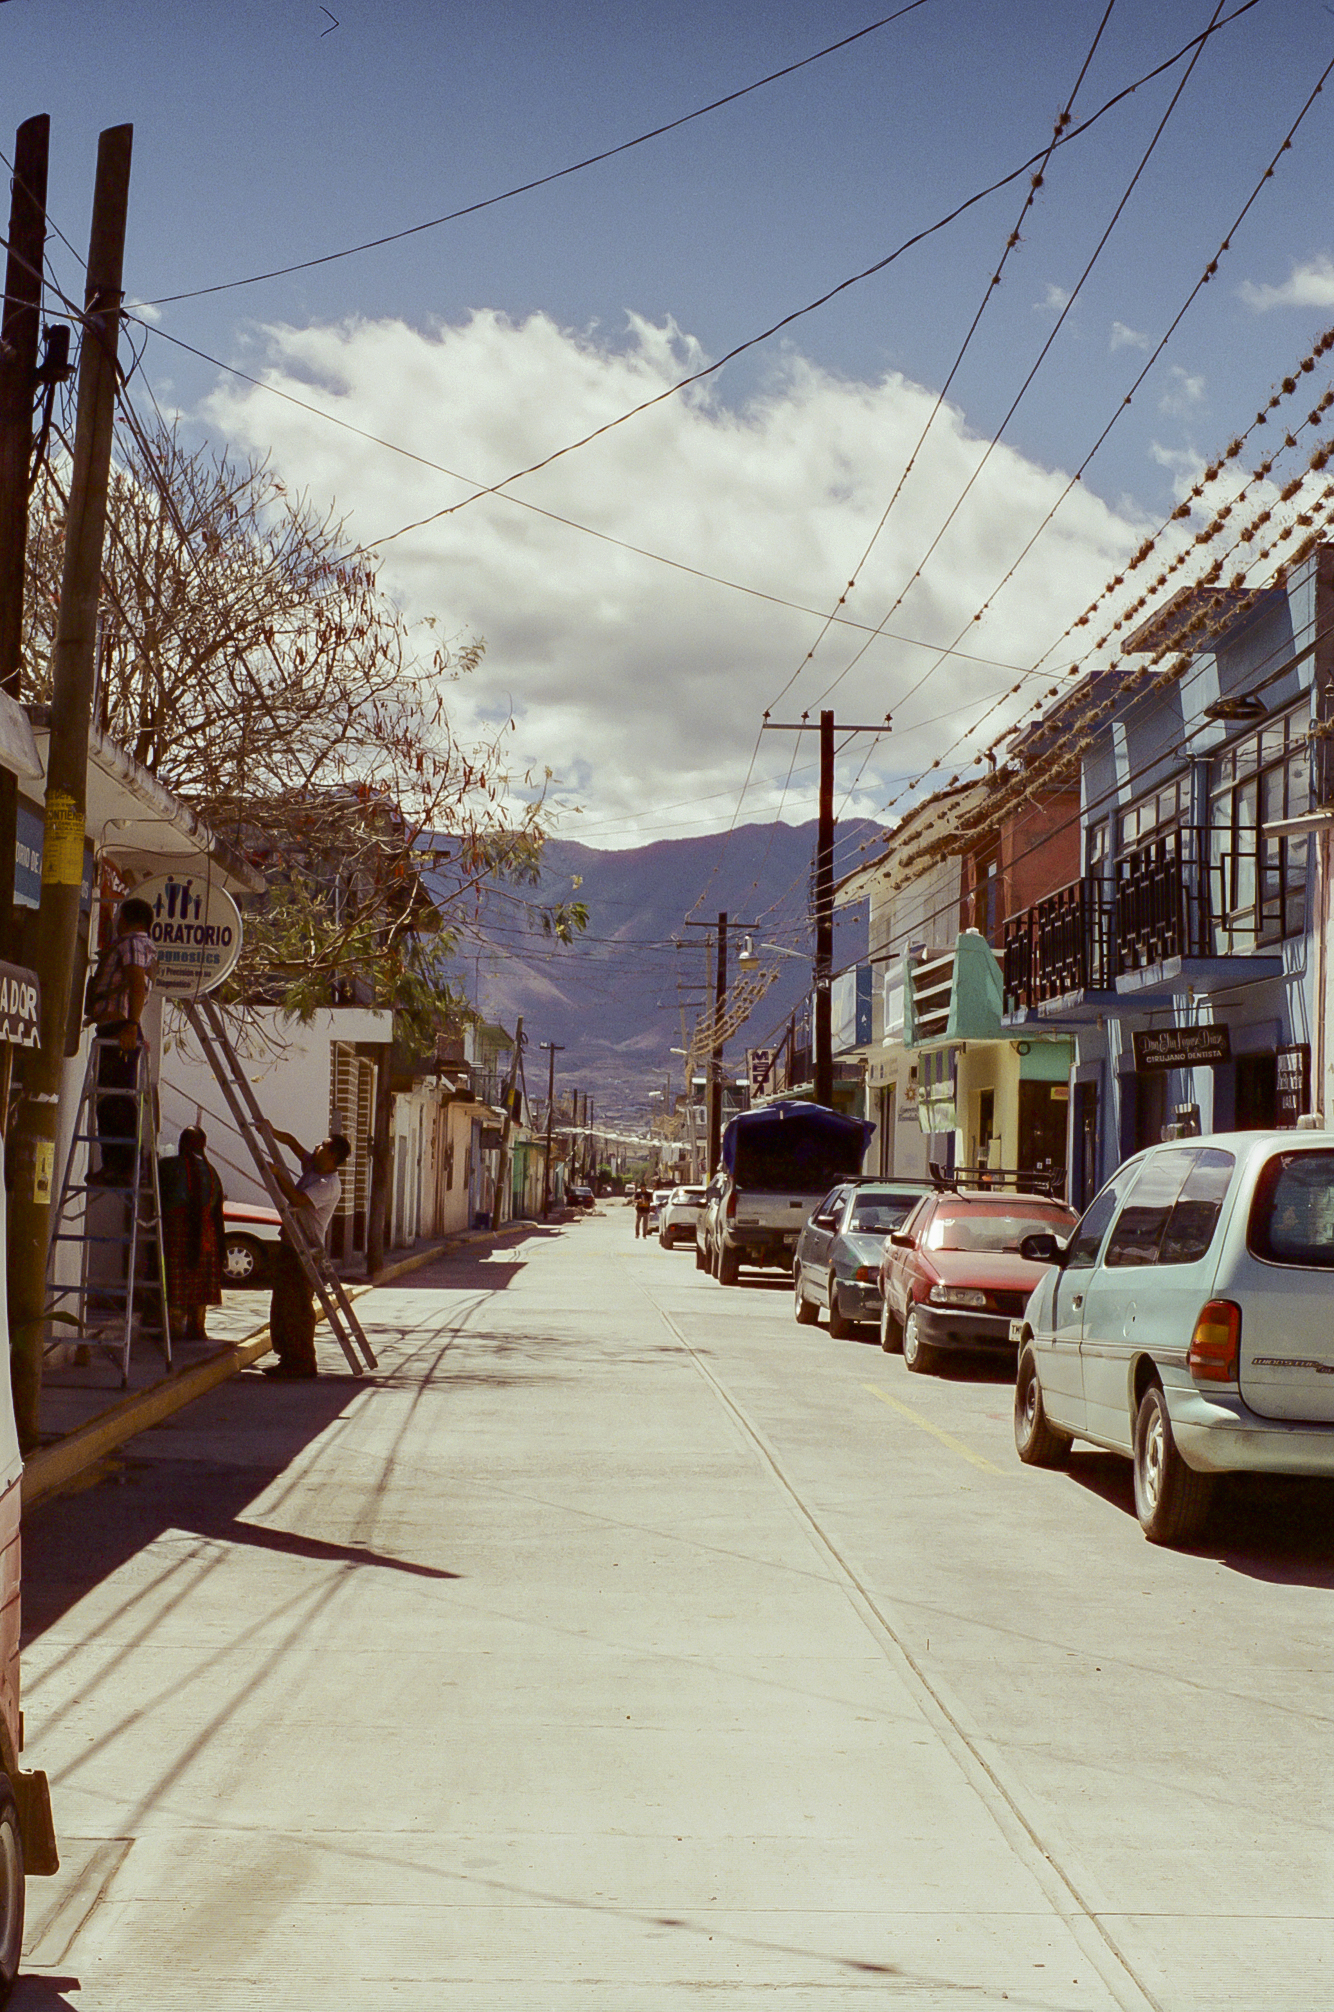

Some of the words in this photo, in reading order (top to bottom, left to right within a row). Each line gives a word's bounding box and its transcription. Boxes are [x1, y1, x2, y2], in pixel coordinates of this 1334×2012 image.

[151, 922, 232, 946] ORATORIO
[157, 950, 220, 964] agnostics
[1146, 1053, 1186, 1063] CIRUJANO
[1187, 1050, 1222, 1060] DENTISTA
